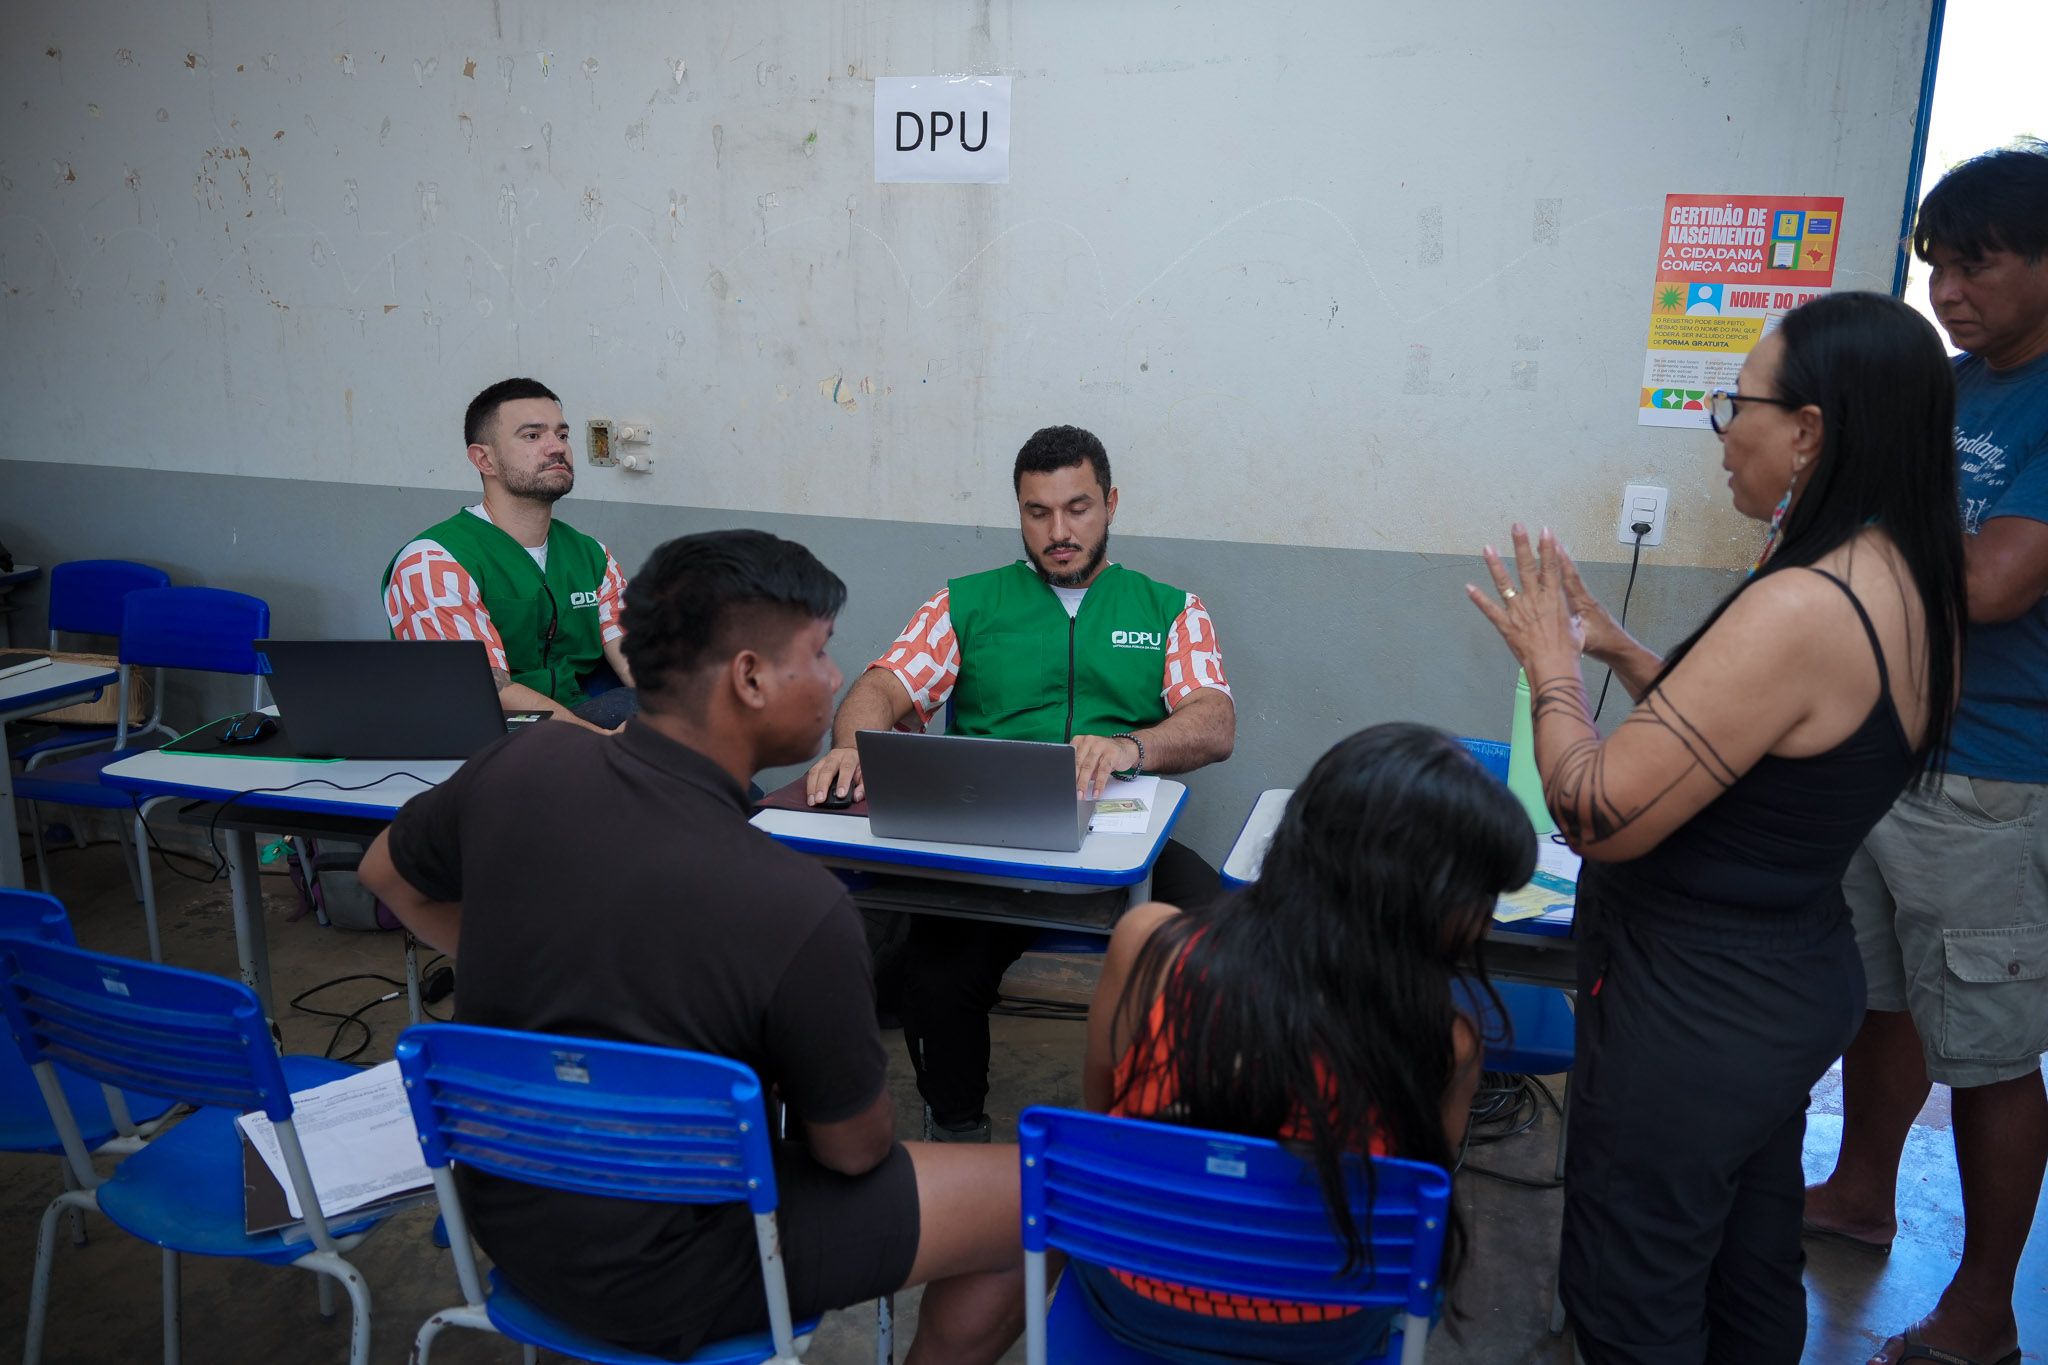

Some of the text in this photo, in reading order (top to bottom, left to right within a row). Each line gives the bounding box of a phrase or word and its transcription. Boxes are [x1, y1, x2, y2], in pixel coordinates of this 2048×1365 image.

[896, 110, 988, 152] DPU
[1670, 203, 1768, 226] CERTIDÃO DE
[1667, 226, 1766, 246] NASCIMENTO
[1663, 247, 1763, 260] A CIDADANIA
[1661, 260, 1762, 274] COMEÇA AQUI
[1729, 291, 1769, 309] NOME
[1773, 293, 1794, 309] DO
[1128, 631, 1161, 646] DPU
